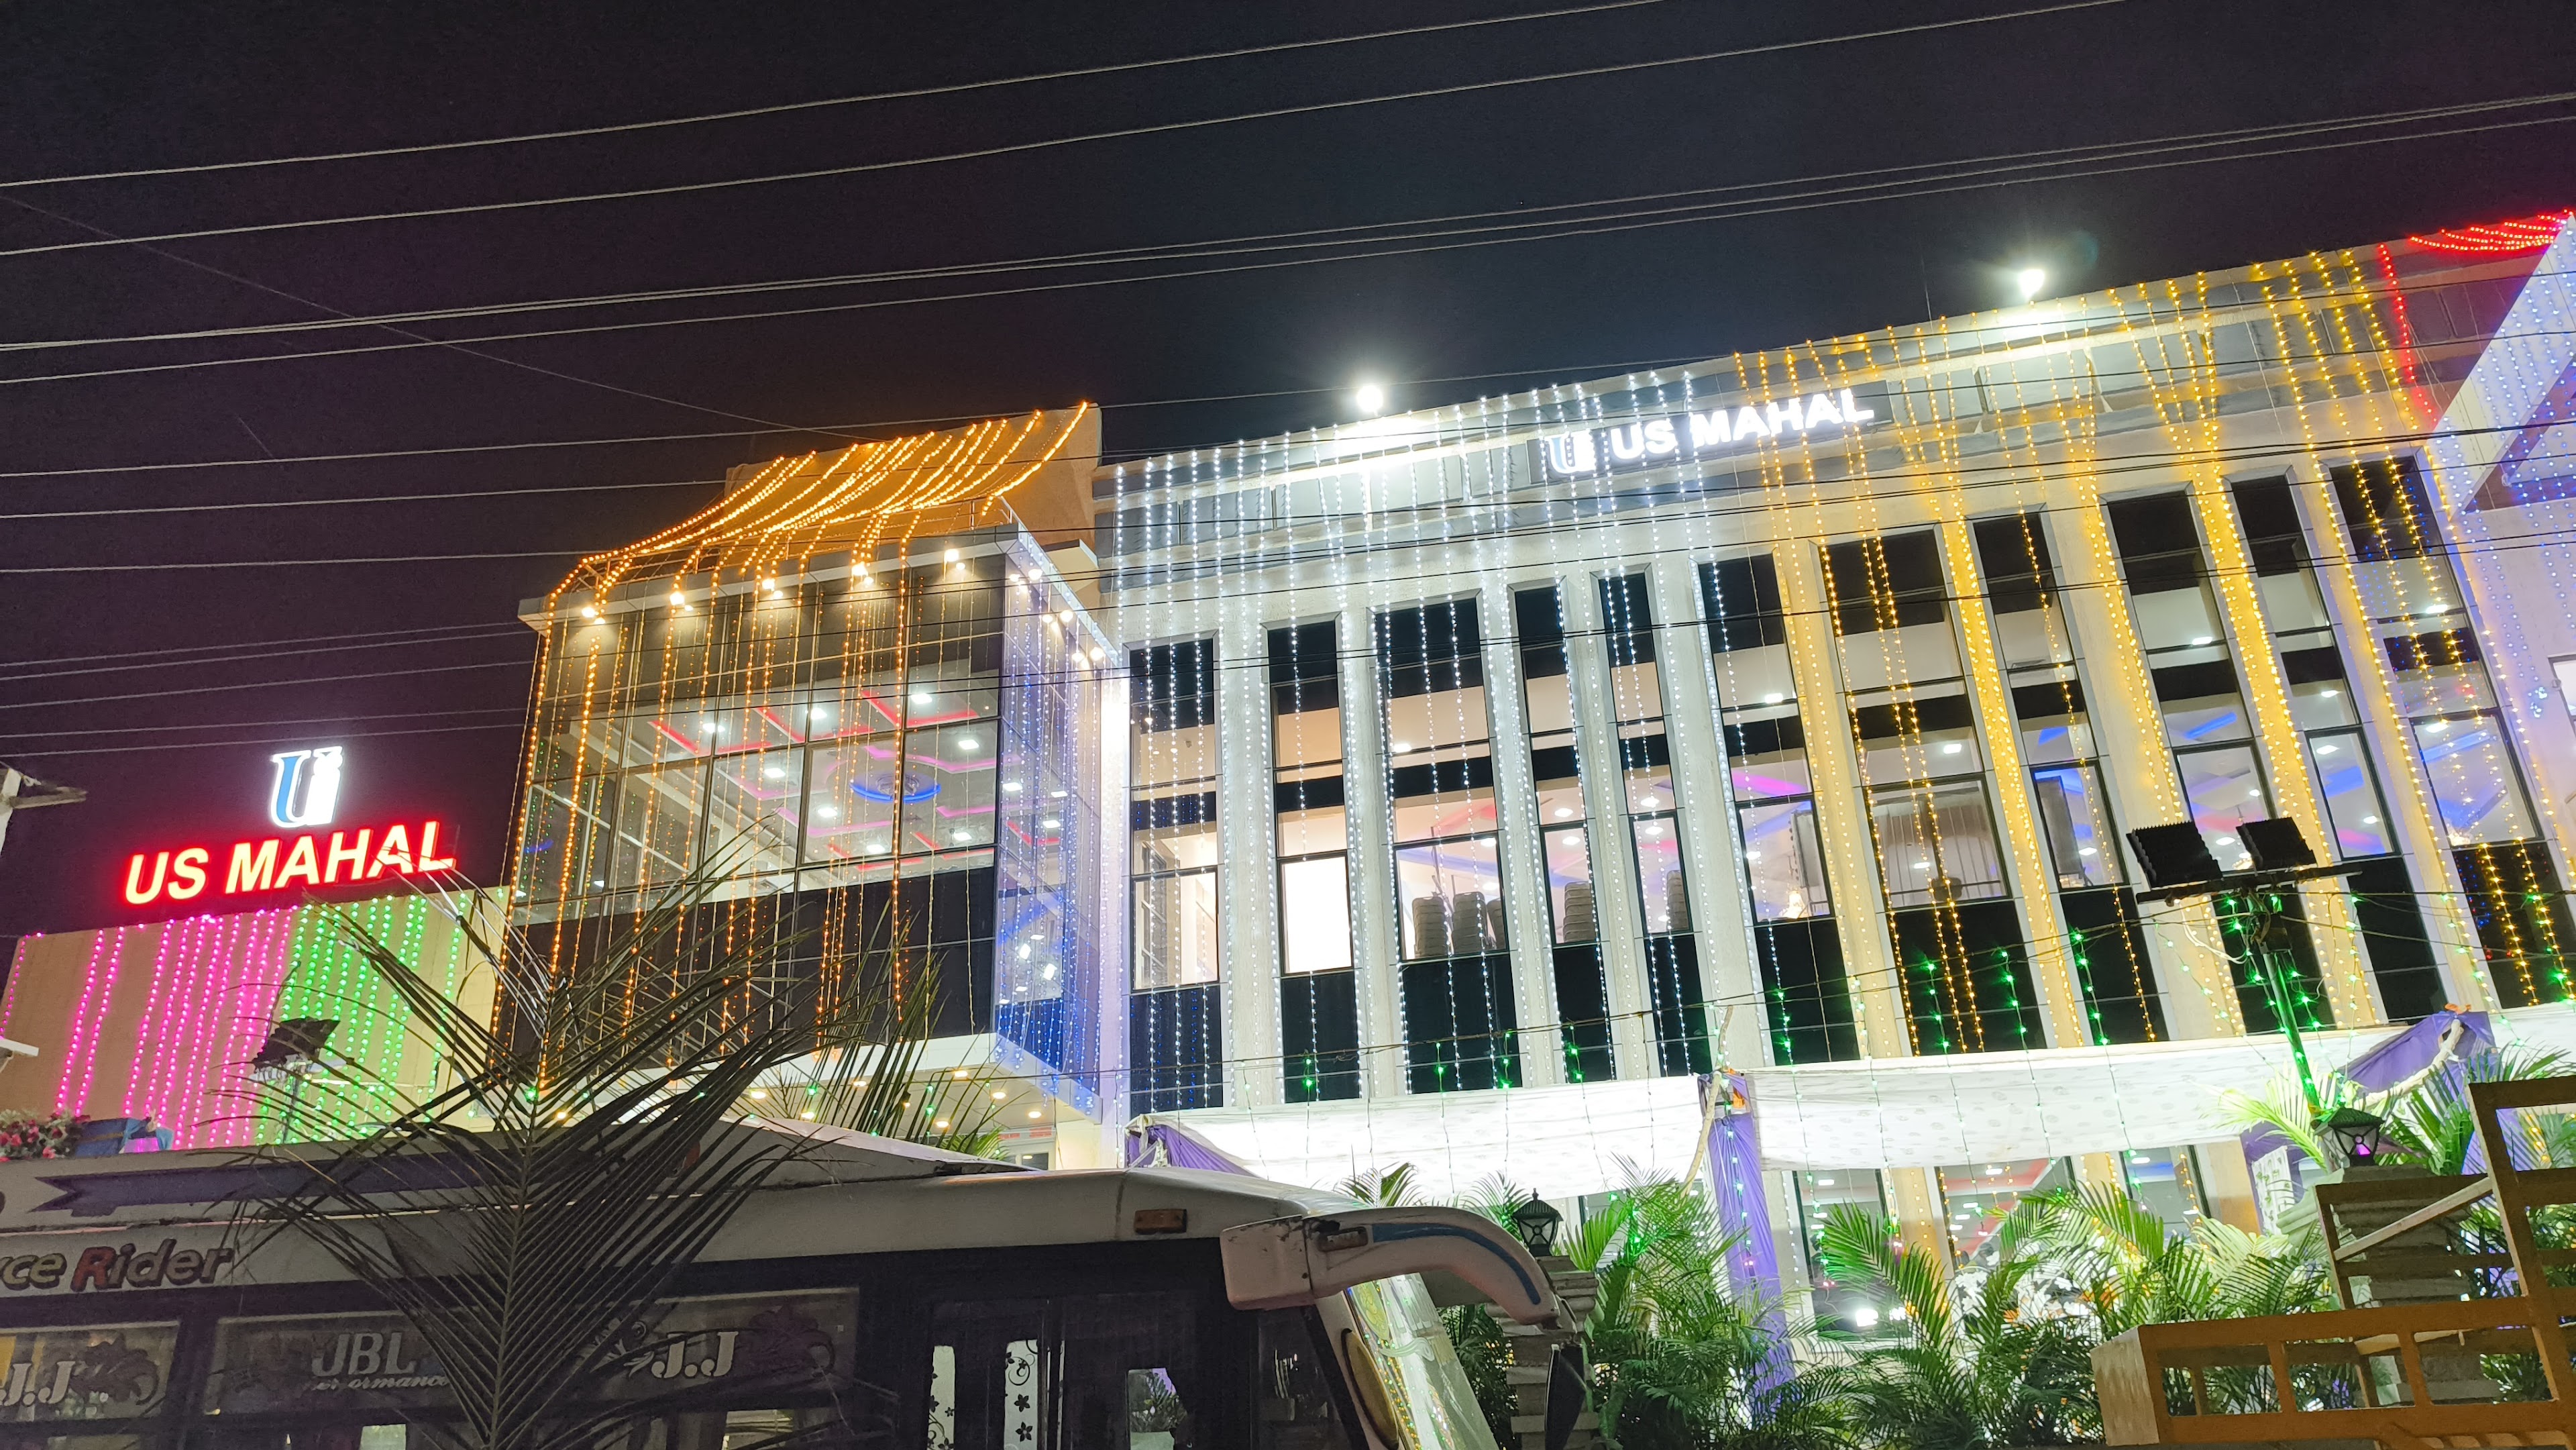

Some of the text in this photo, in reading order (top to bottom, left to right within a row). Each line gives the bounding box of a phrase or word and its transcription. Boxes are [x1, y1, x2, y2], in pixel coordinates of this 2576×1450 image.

[1610, 387, 1875, 460] US MAHAL
[125, 821, 457, 905] US MAHAL
[70, 1238, 235, 1292] Rider
[311, 1331, 417, 1377] JBL
